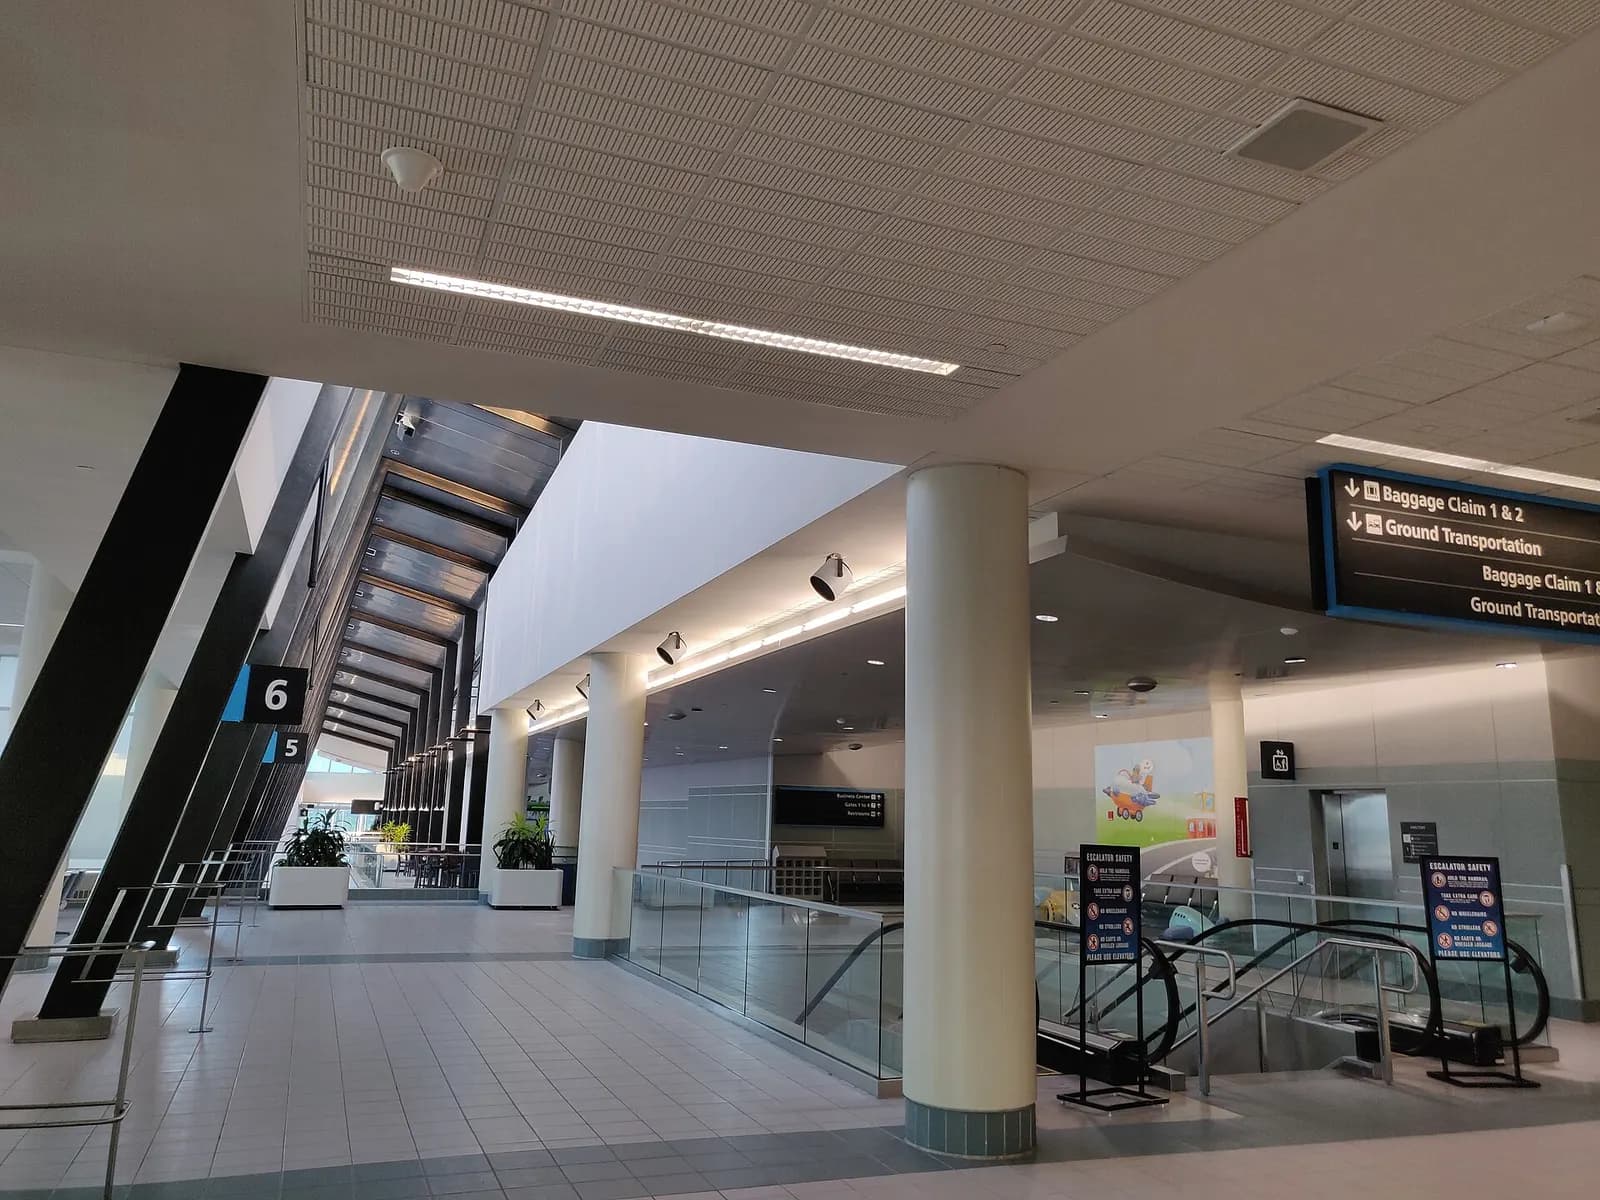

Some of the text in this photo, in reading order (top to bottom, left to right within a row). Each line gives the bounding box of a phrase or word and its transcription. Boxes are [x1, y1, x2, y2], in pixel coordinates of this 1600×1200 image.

[1383, 485, 1524, 522] Baggage Claim 1 & 2
[1386, 519, 1542, 556] Ground Transportation
[1482, 565, 1541, 590] Baggage
[1544, 574, 1581, 593] Claim
[1584, 580, 1592, 594] 1
[1470, 597, 1522, 617] Ground
[264, 680, 288, 710] 6
[285, 739, 298, 756] 5
[1087, 853, 1133, 862] ESCALATOR SAFETY
[1429, 862, 1465, 871] ESCALATOR
